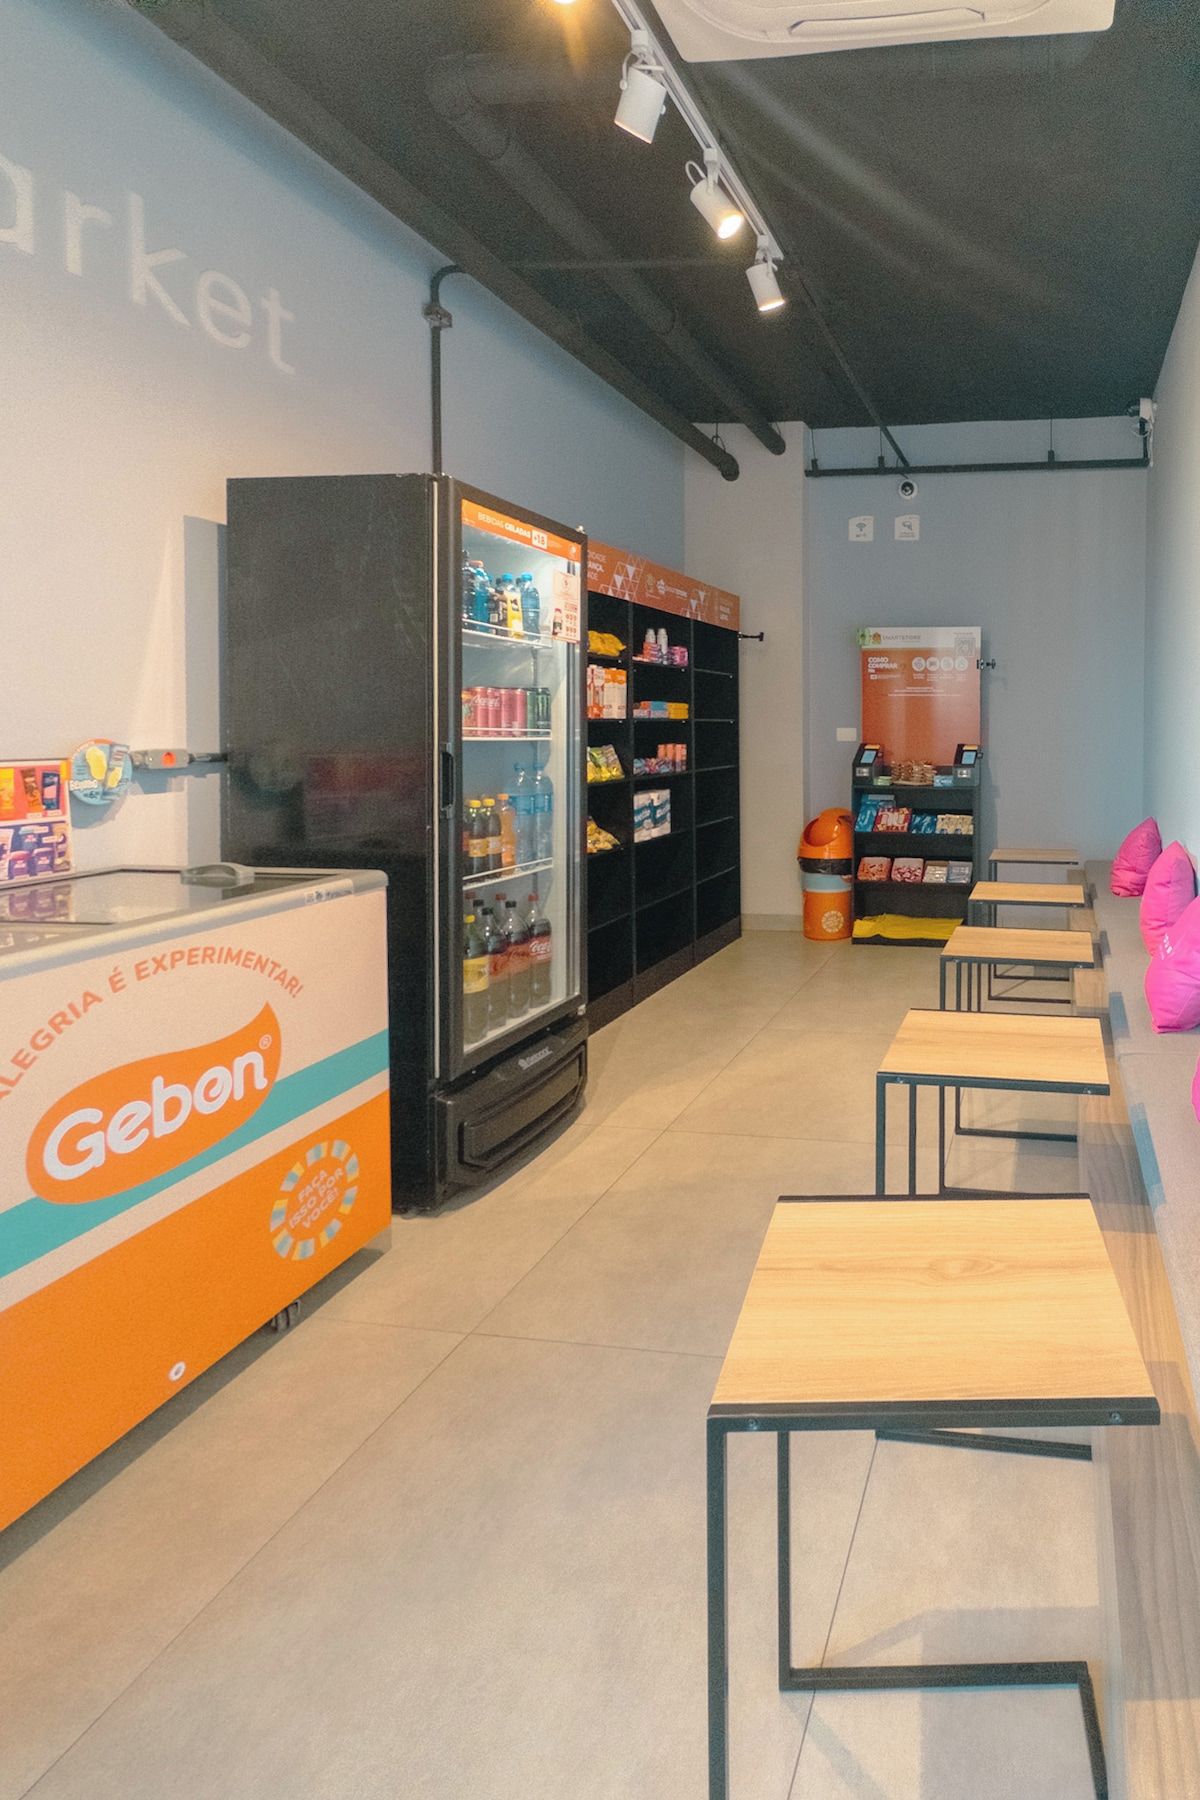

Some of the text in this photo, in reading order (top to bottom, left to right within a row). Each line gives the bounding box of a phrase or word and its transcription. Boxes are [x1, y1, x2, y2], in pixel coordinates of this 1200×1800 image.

[504, 522, 532, 539] GELADAS
[0, 946, 304, 1099] LEGRIA É EXPERIMENTAR!
[43, 1051, 268, 1181] Gebon
